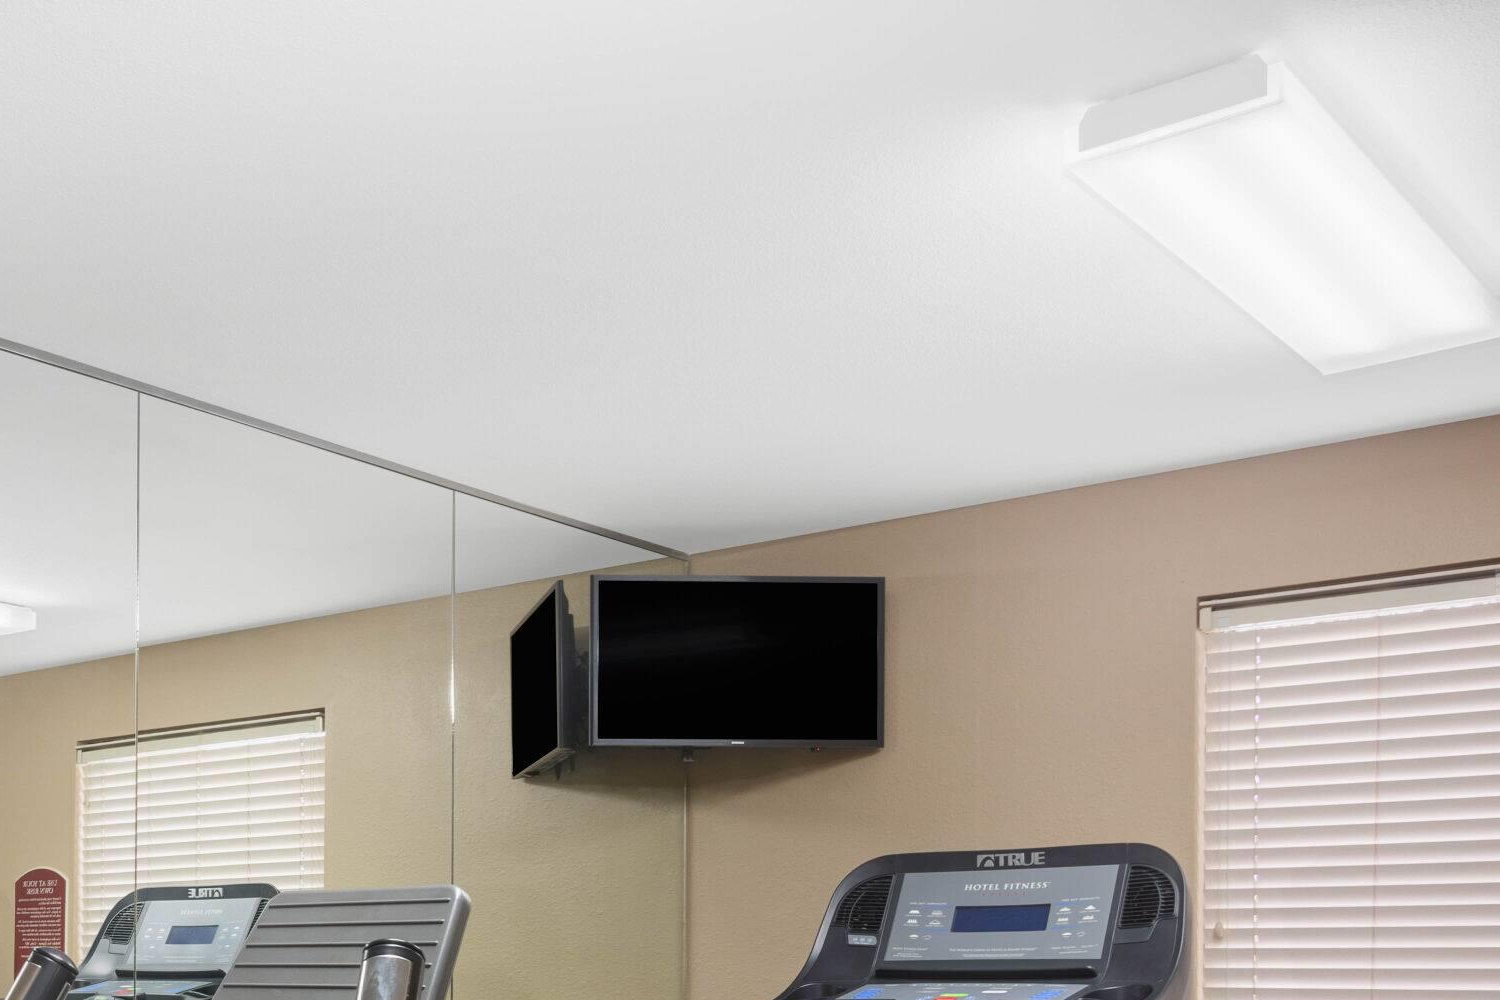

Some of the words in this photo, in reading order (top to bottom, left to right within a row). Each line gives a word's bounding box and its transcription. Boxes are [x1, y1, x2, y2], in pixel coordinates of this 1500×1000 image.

[995, 851, 1046, 867] TRUE
[964, 882, 1001, 891] HOTEL
[1003, 881, 1049, 891] FITNESS
